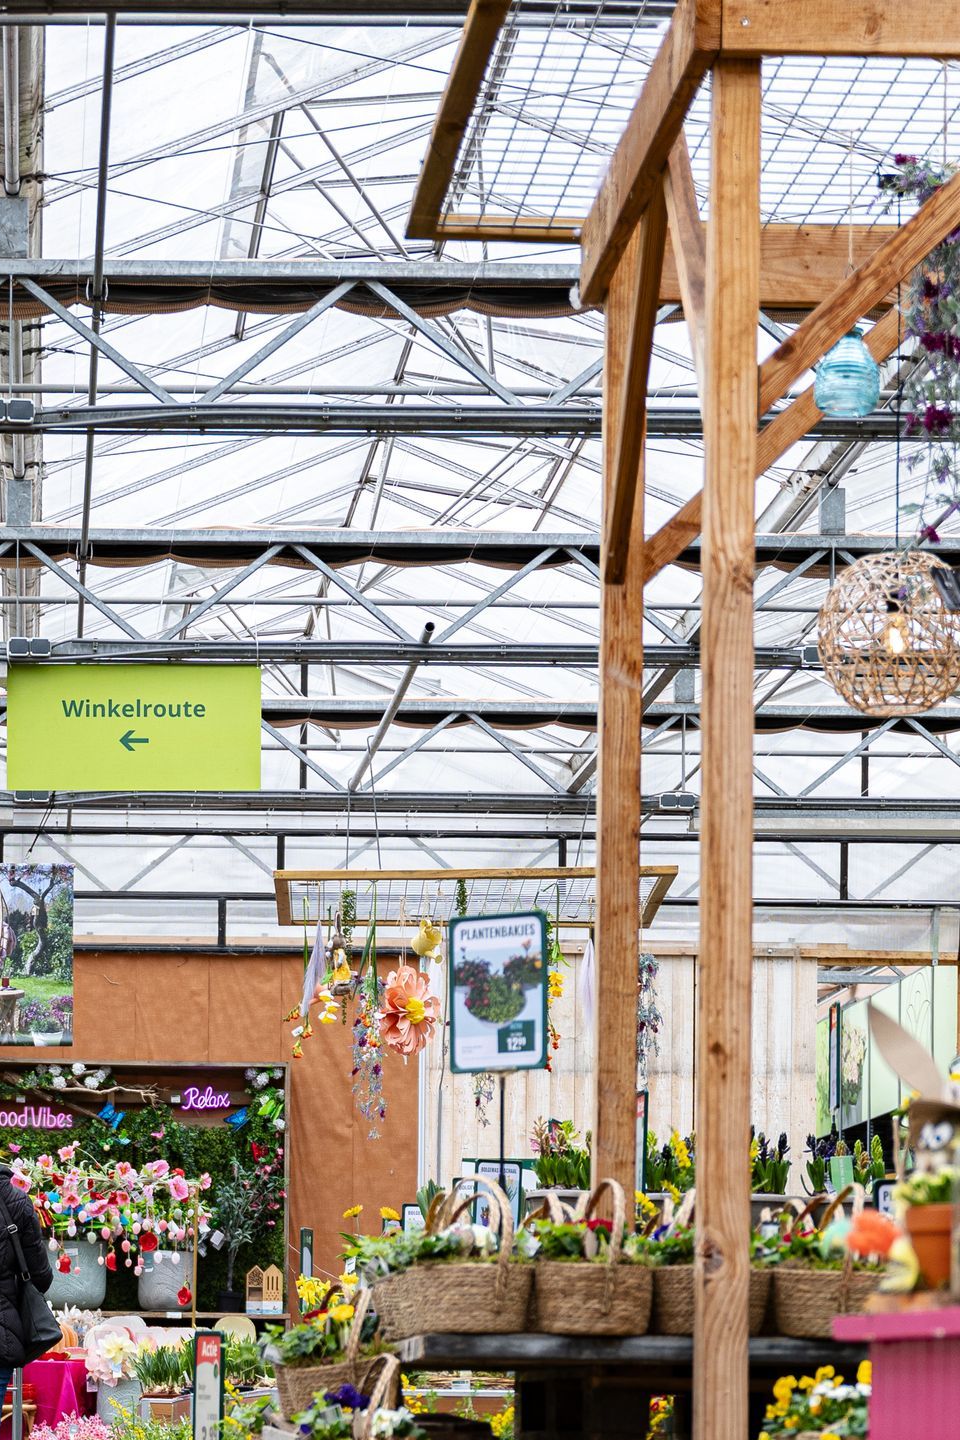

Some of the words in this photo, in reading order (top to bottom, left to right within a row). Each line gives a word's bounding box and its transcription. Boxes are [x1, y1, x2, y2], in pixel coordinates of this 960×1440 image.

[61, 699, 206, 718] Winkelroute
[460, 923, 536, 941] PLANTENBAKJES
[181, 1086, 231, 1111] Relax
[201, 1341, 218, 1357] Actie
